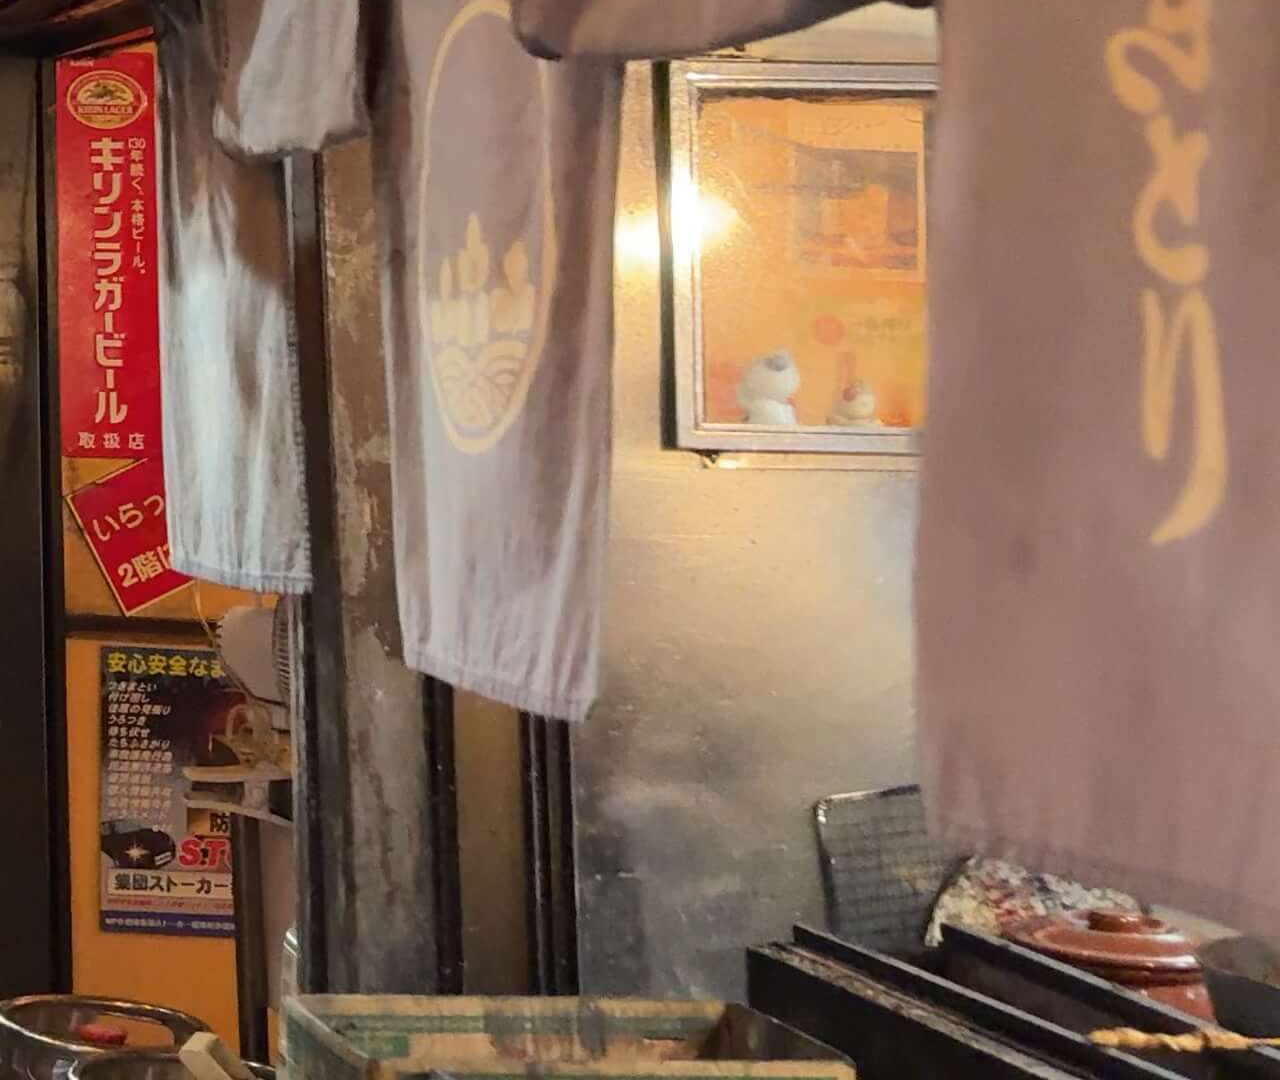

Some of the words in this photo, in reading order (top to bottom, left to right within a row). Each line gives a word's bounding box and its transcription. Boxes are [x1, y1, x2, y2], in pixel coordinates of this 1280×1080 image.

[90, 136, 128, 425] キリンラガービール
[78, 431, 146, 450] 取扱店
[106, 651, 227, 678] 安心安全なま
[114, 872, 233, 895] 集団ストーカー
